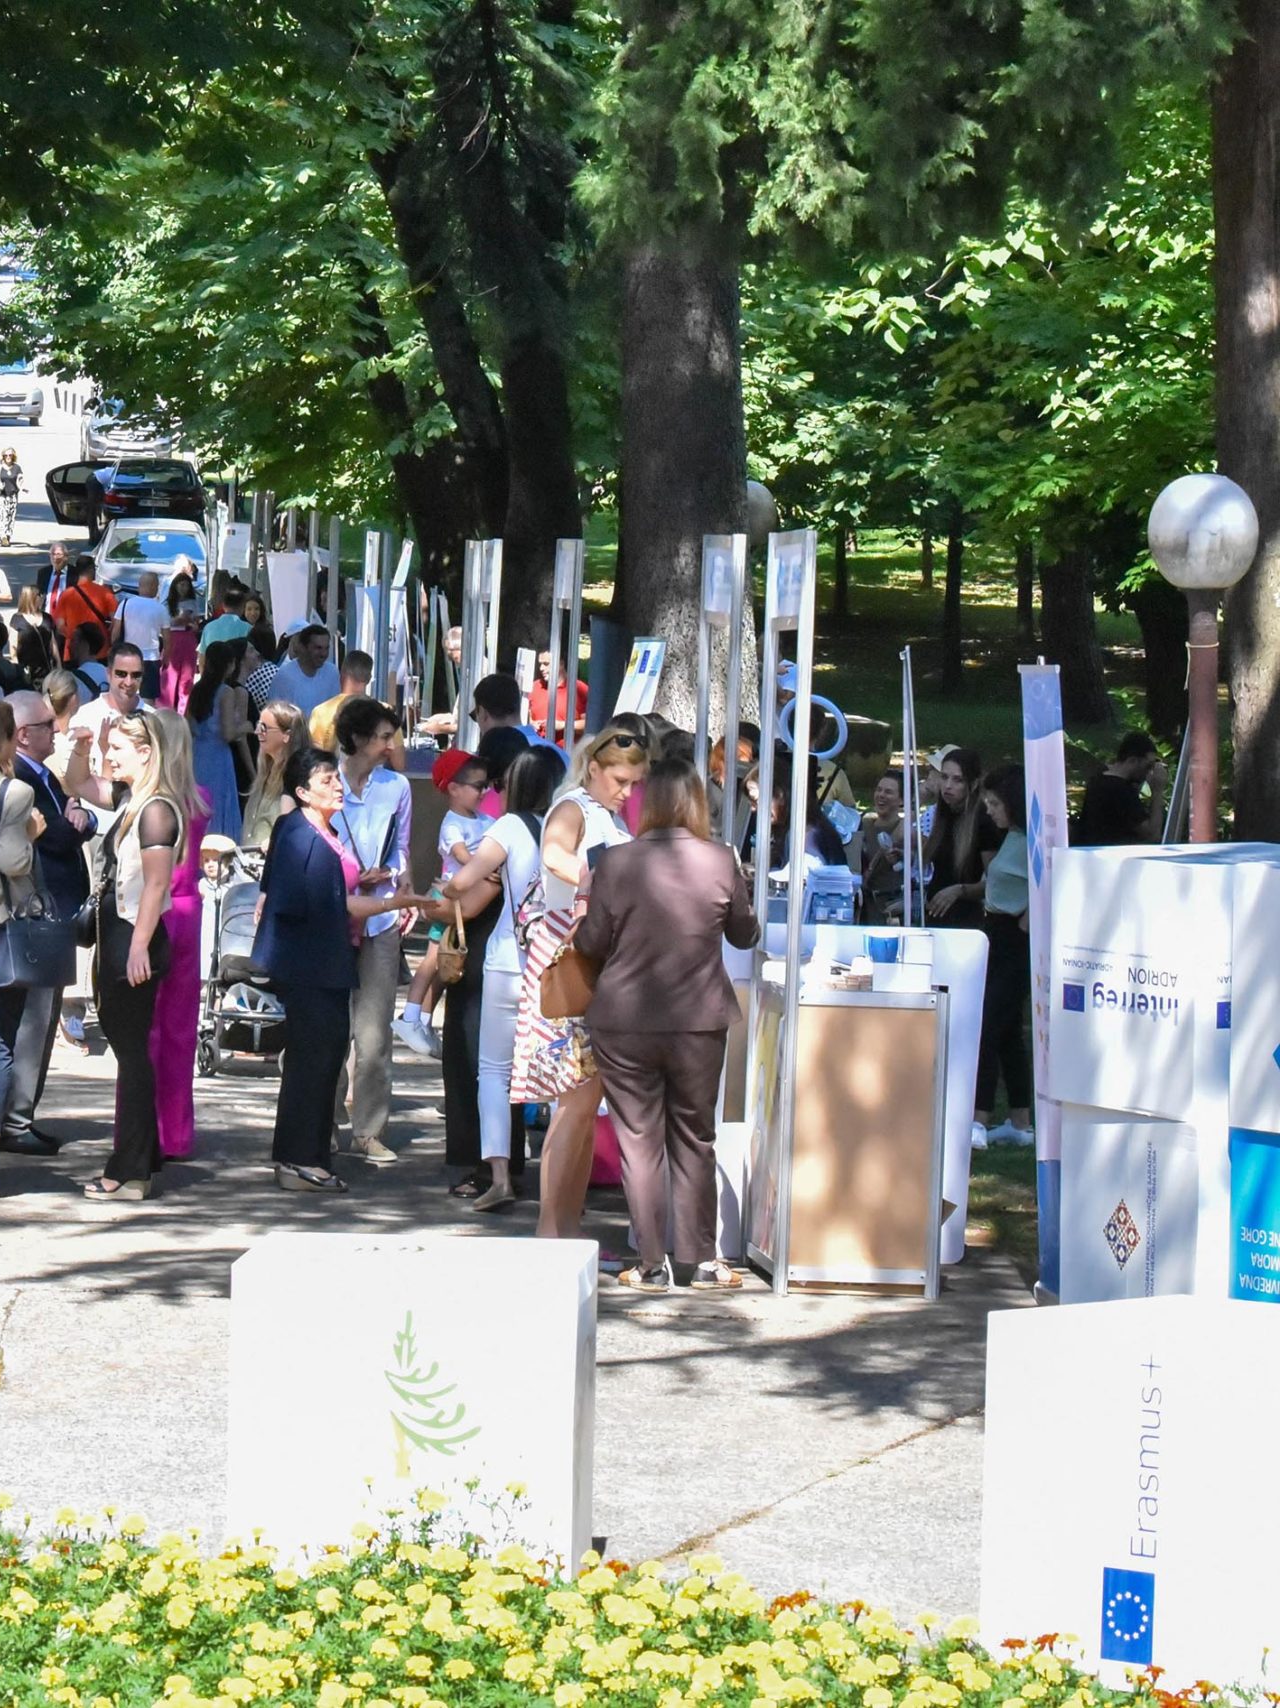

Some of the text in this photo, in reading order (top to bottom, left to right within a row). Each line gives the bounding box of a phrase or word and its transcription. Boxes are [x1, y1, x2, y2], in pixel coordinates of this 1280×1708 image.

[1127, 967, 1178, 988] ADRION
[1092, 981, 1179, 1026] Interreg
[1241, 1226, 1267, 1245] GORE
